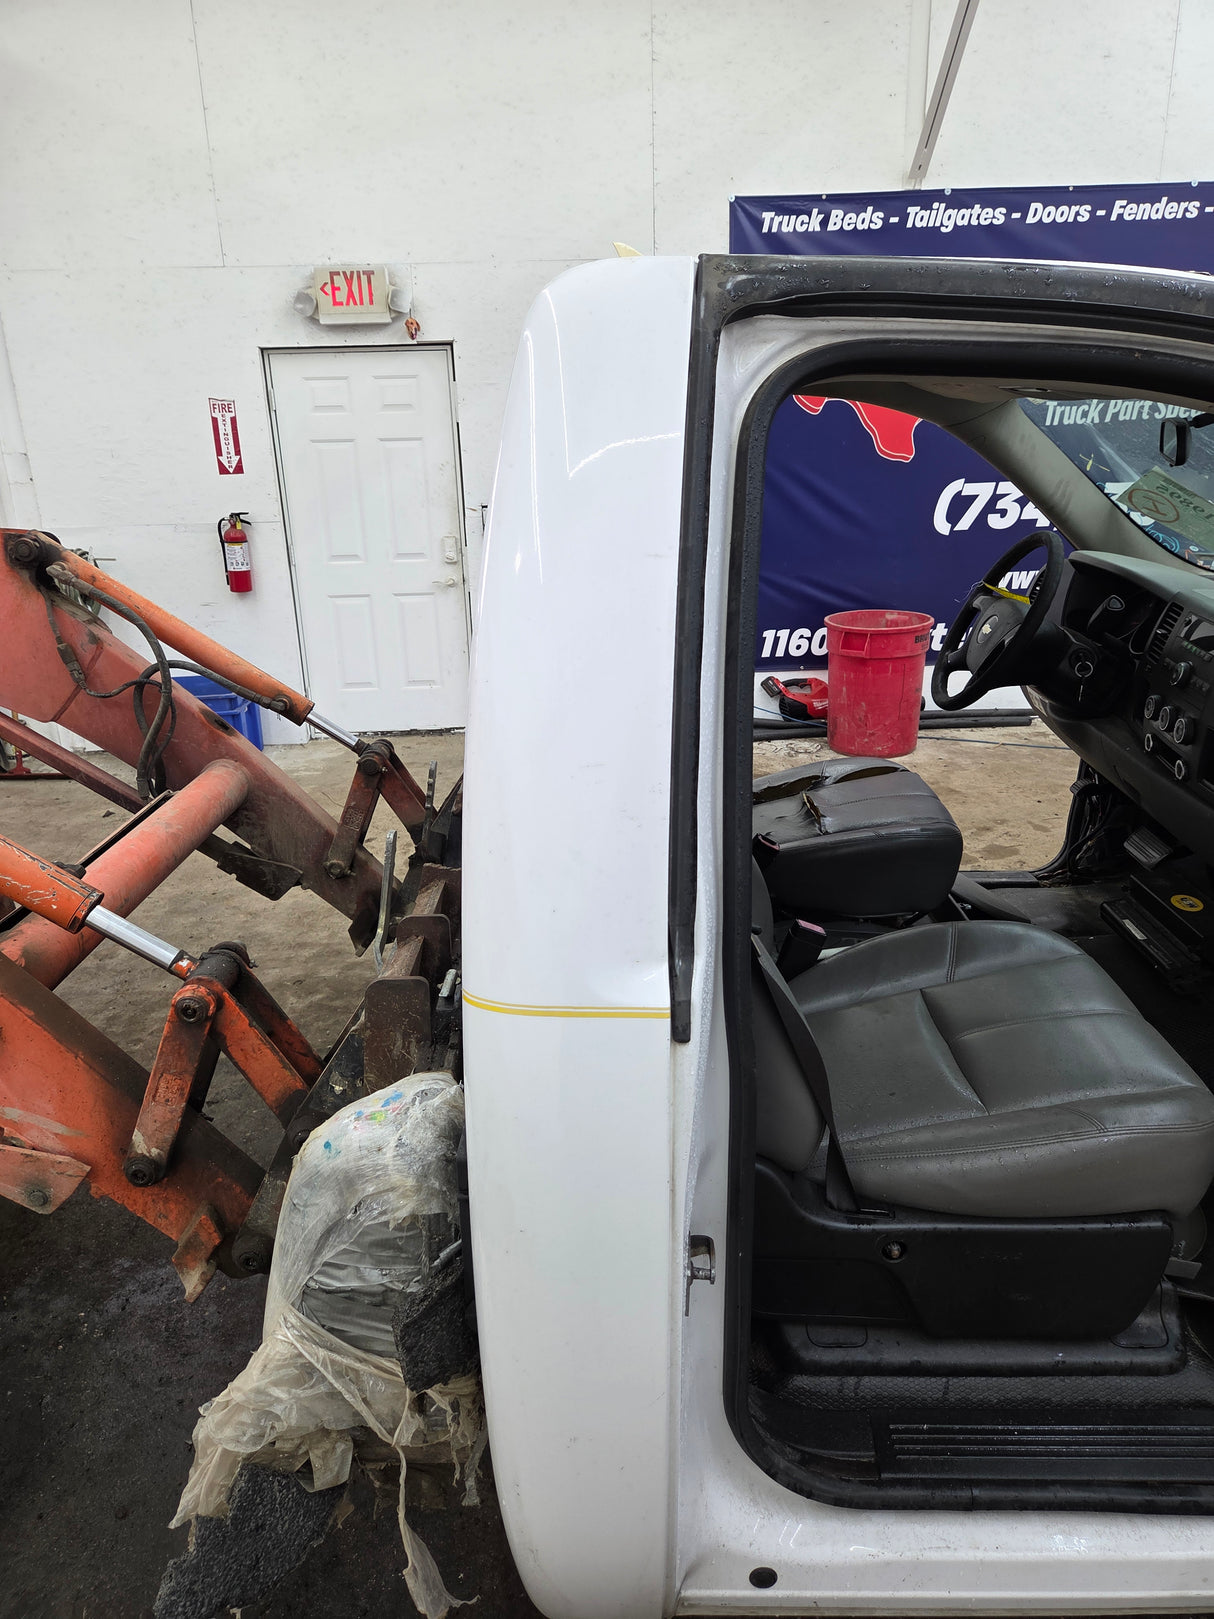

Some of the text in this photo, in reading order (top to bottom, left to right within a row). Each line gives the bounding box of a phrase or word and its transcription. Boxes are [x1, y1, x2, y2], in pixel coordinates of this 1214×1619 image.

[761, 208, 825, 233] Truck
[827, 206, 885, 231] Beds
[906, 202, 1006, 233] Tailgates
[1025, 202, 1091, 224] Doors
[1110, 197, 1200, 221] Fenders
[329, 270, 375, 306] EXIT
[212, 403, 233, 413] FIRE
[1045, 399, 1104, 426] Truck
[1104, 399, 1153, 423] Part
[221, 413, 233, 469] EXTINGUISHER
[933, 477, 1058, 536] (734
